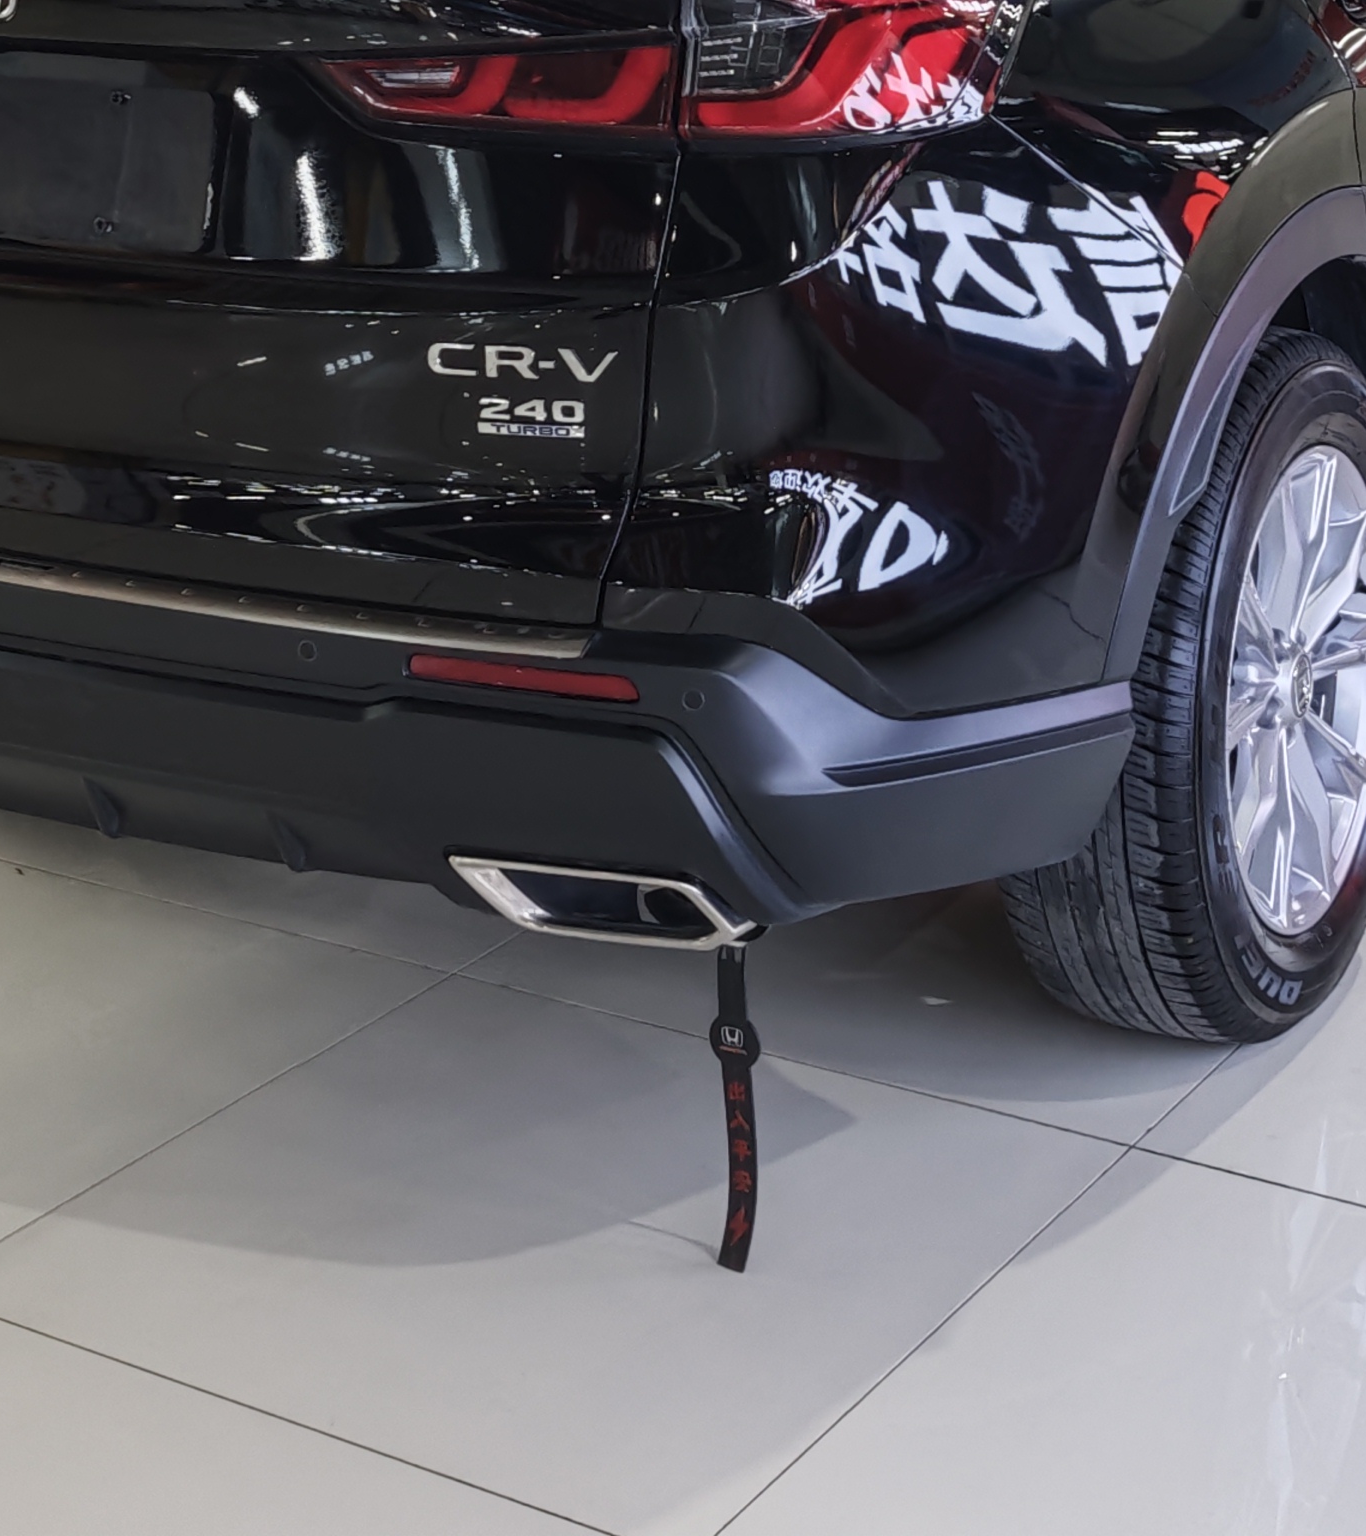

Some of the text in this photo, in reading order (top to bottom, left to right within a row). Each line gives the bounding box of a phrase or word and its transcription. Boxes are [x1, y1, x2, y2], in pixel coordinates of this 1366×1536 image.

[427, 342, 619, 383] CR-V
[478, 397, 586, 424] 240
[490, 422, 572, 438] TURBO
